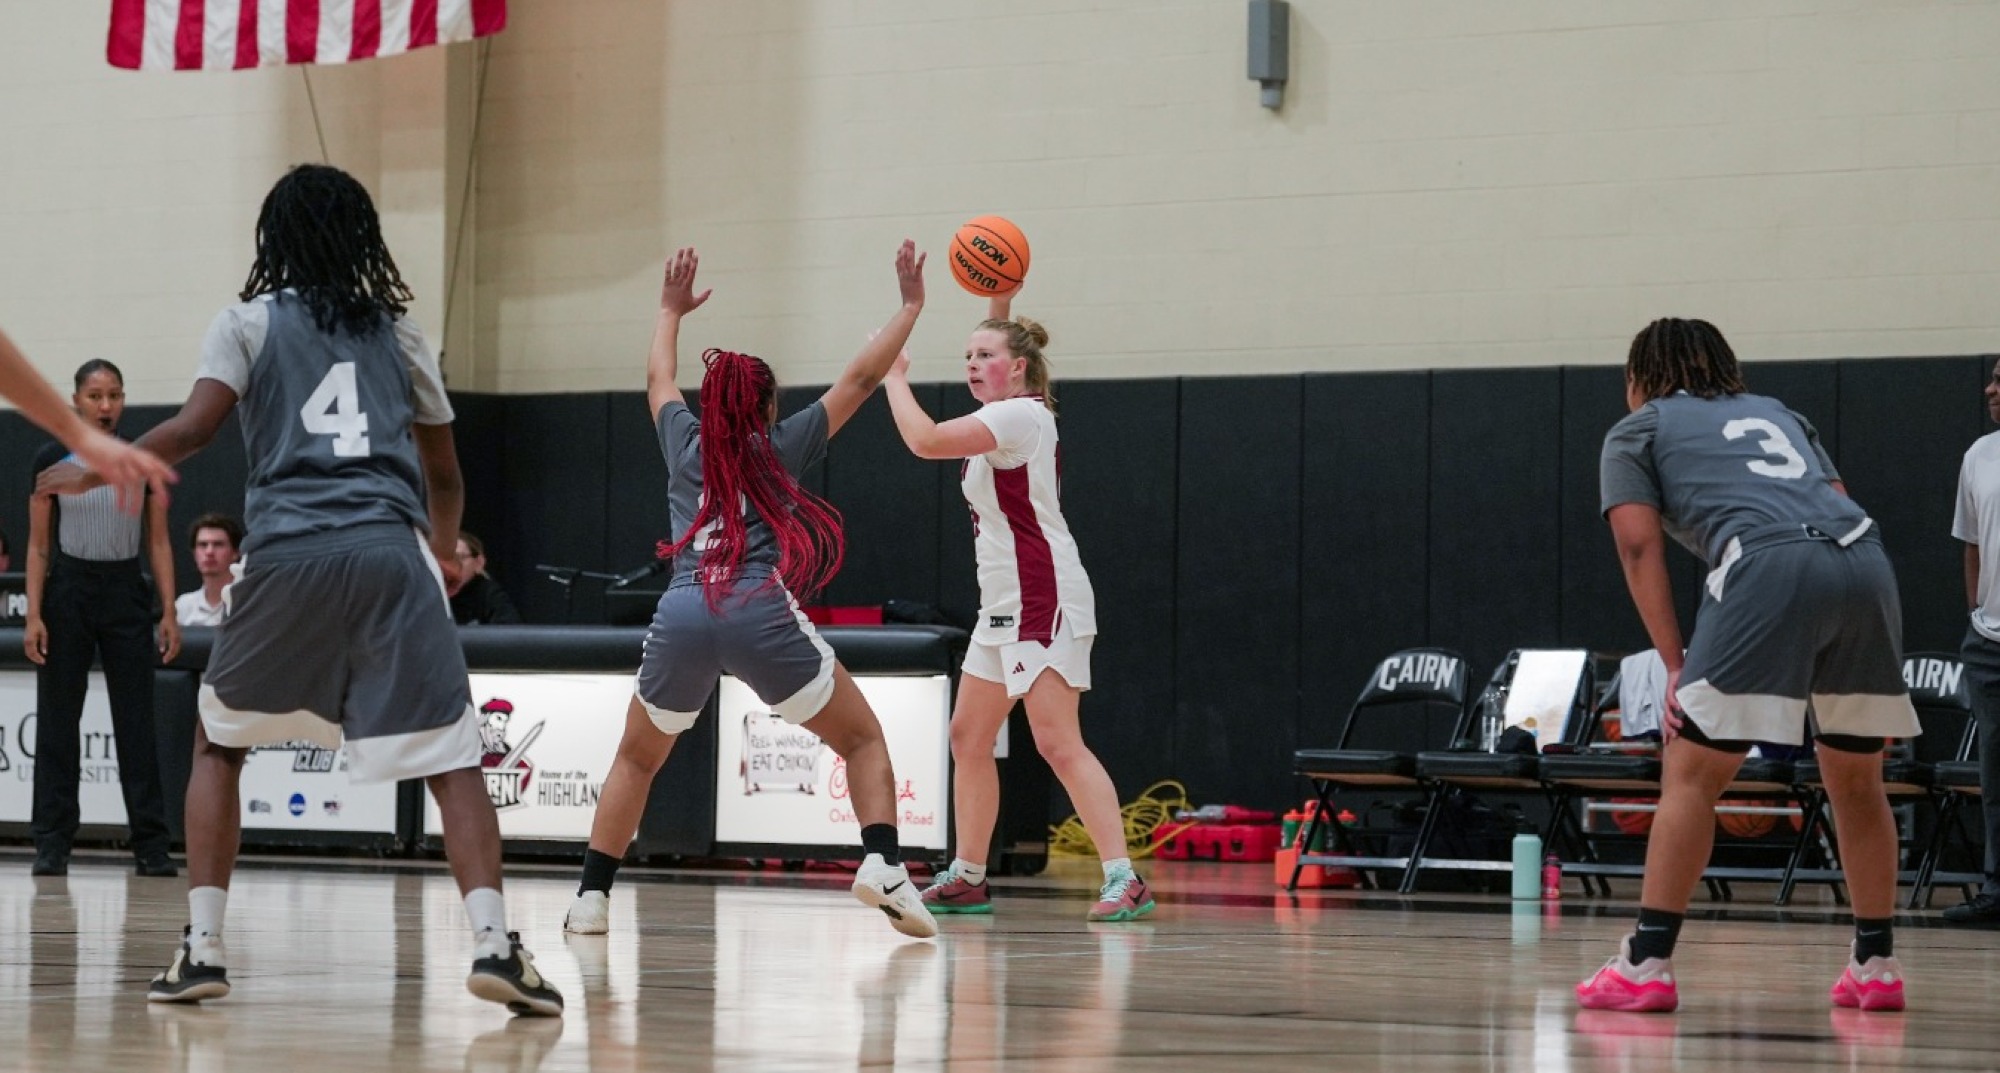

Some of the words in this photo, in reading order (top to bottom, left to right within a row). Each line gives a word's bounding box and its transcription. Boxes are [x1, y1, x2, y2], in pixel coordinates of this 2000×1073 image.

[971, 235, 1009, 266] NCAA
[955, 250, 998, 290] Wilson
[300, 361, 370, 457] 4
[1722, 417, 1807, 479] 3
[1378, 653, 1459, 692] CAIRN
[1902, 658, 1964, 697] AIRN
[293, 750, 336, 772] CLUB
[753, 753, 773, 771] EAT
[538, 782, 600, 806] HIGHLAN
[829, 808, 858, 823] Oxfo
[905, 810, 934, 825] Road
